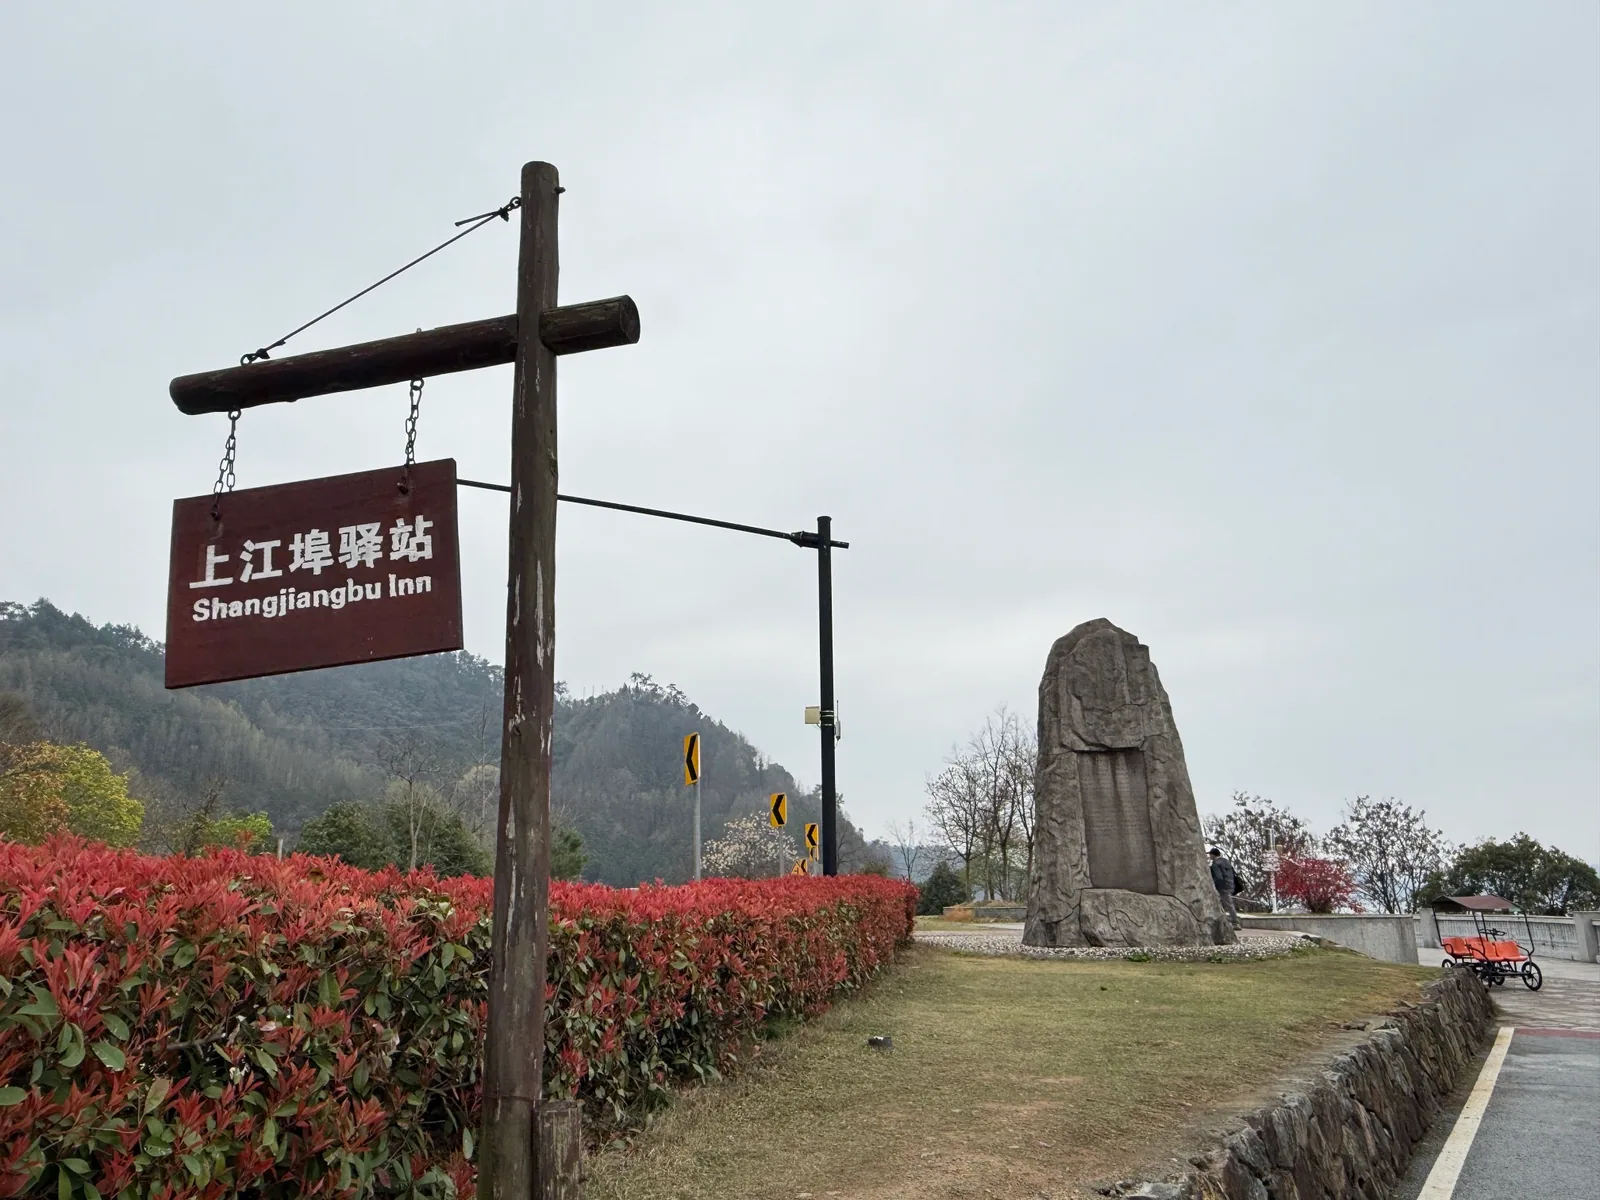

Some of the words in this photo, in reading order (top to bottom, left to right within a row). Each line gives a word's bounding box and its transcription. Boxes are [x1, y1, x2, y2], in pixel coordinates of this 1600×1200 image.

[189, 514, 434, 589] 上江埠驿站
[192, 578, 382, 622] Shangjiangbu
[388, 573, 432, 598] Inn
